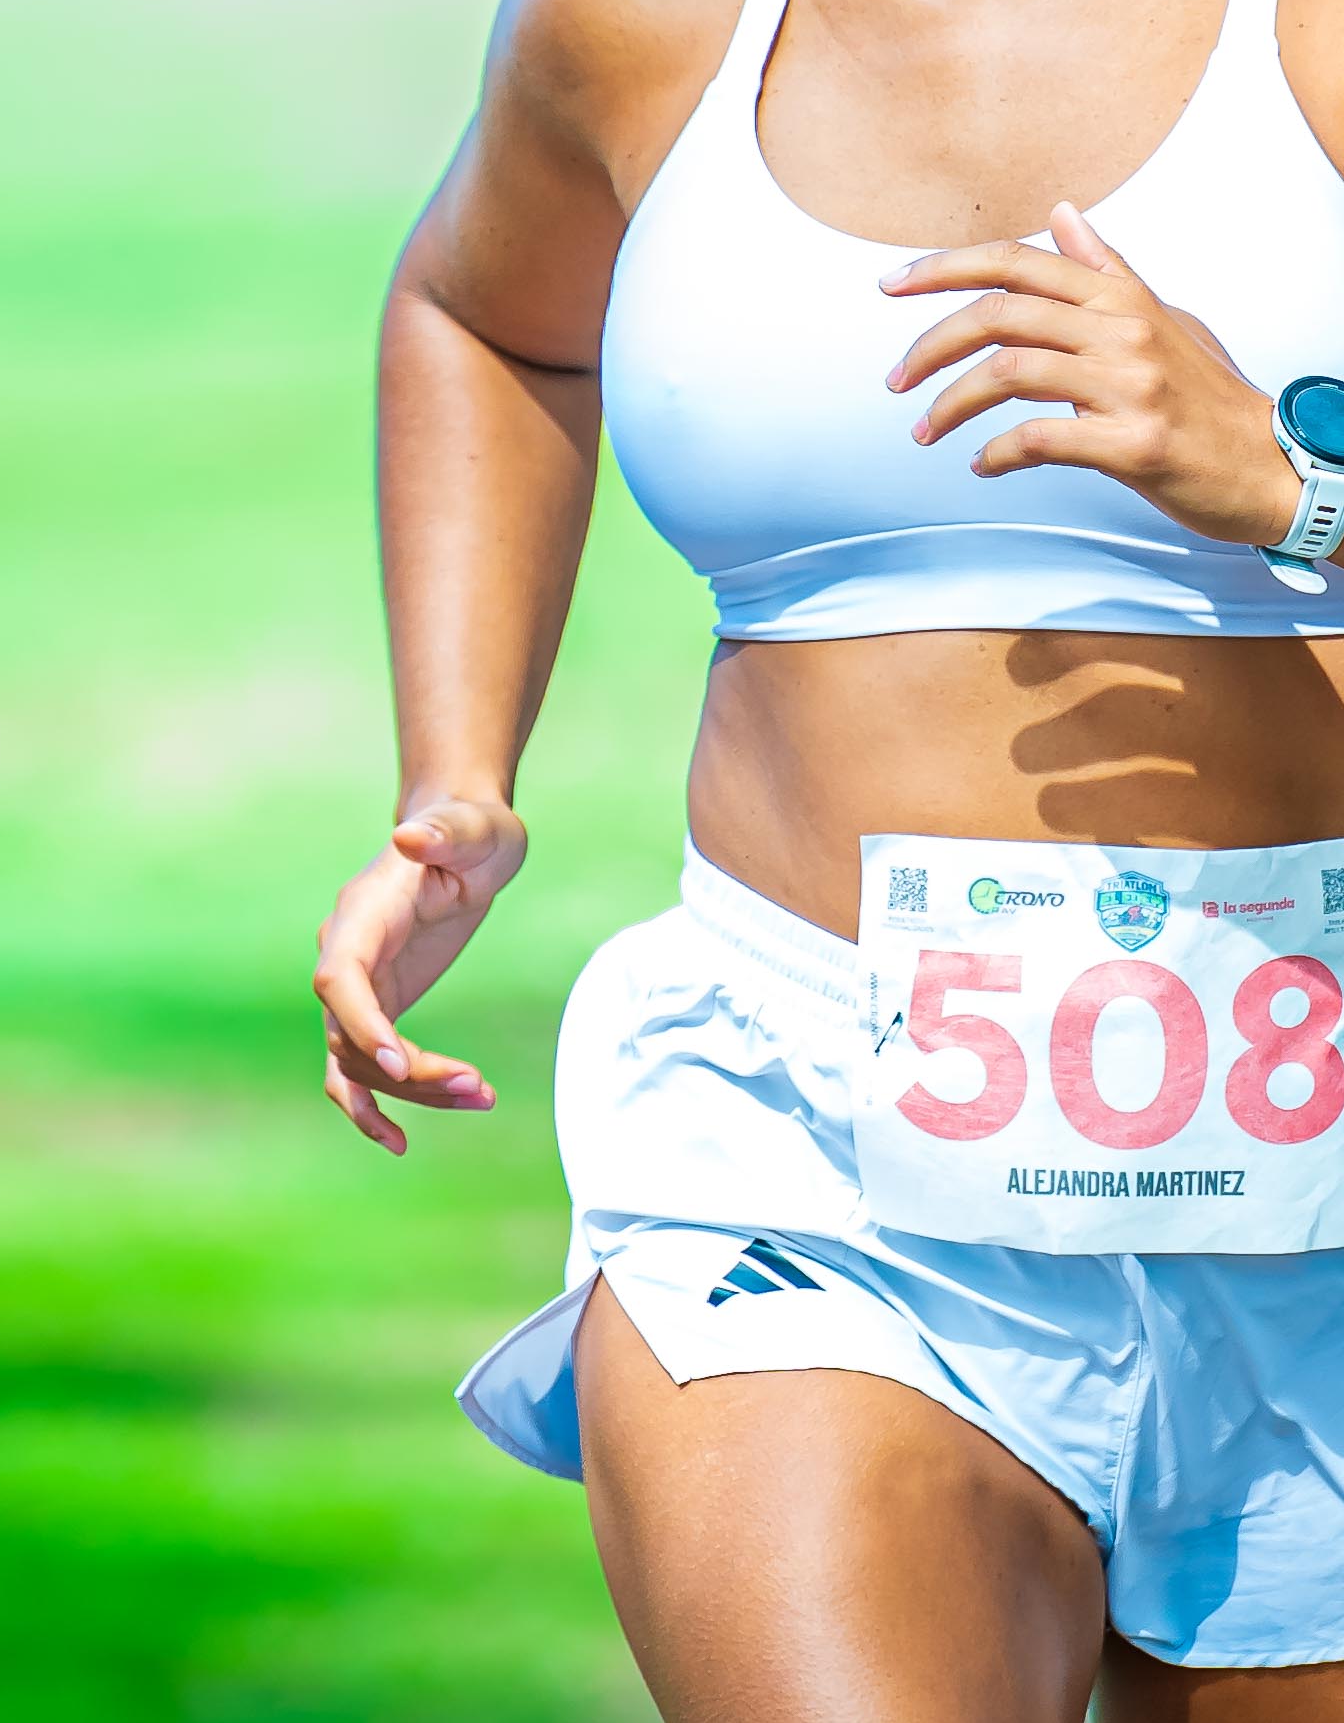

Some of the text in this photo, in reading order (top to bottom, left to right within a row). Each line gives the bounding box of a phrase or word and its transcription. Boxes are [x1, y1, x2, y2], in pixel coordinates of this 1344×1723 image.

[994, 890, 1066, 908] CRONO
[1223, 896, 1296, 916] la segunda
[1007, 1167, 1246, 1198] ALEJANDRA MARTINEZ
